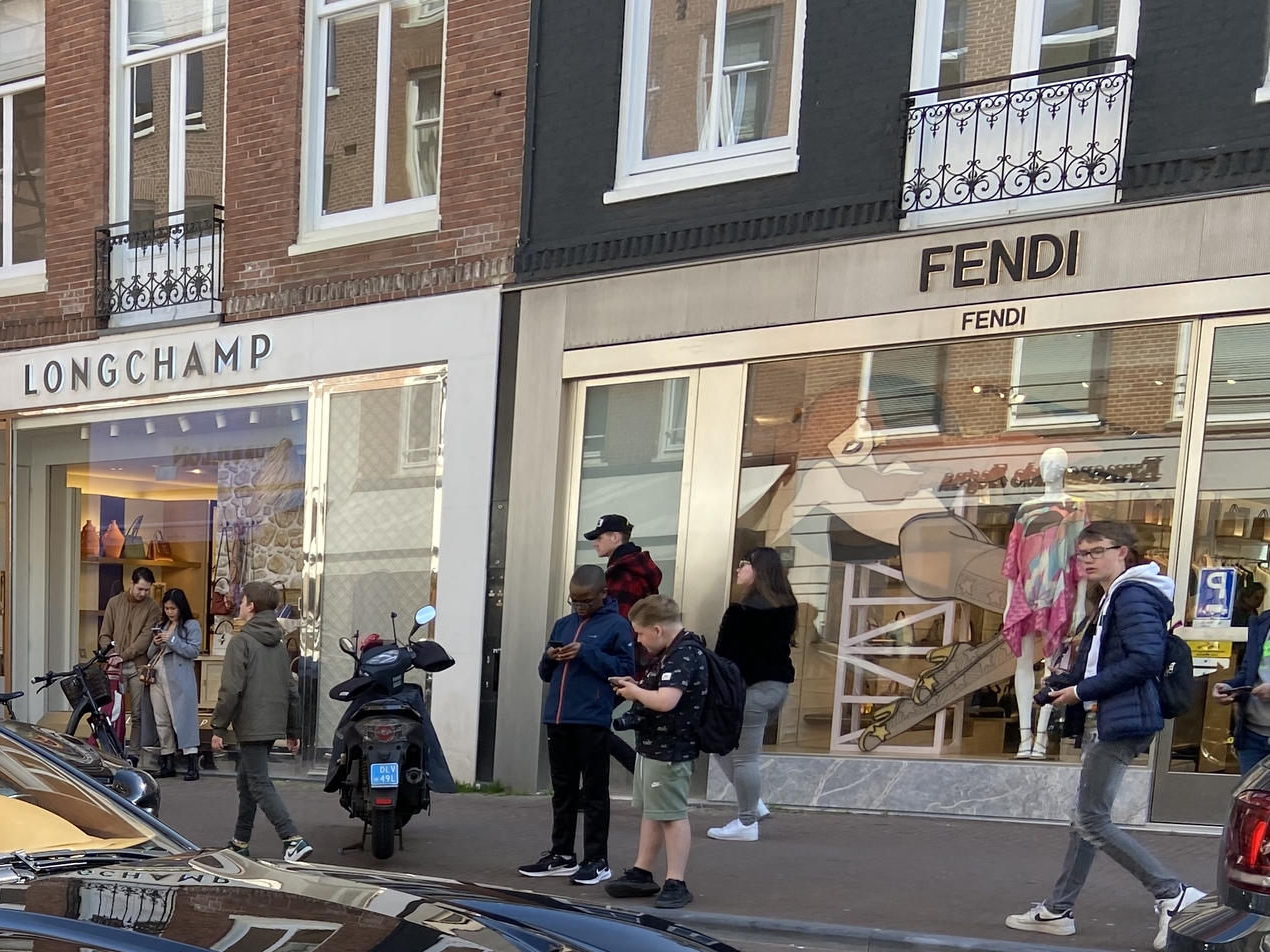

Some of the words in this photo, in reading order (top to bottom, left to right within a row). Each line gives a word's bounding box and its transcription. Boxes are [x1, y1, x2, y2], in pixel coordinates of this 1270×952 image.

[919, 229, 1080, 293] FENDI
[961, 306, 1026, 331] FENDI
[24, 333, 272, 396] LONGCHAMP
[379, 765, 396, 774] DLV
[379, 774, 396, 783] 49L
